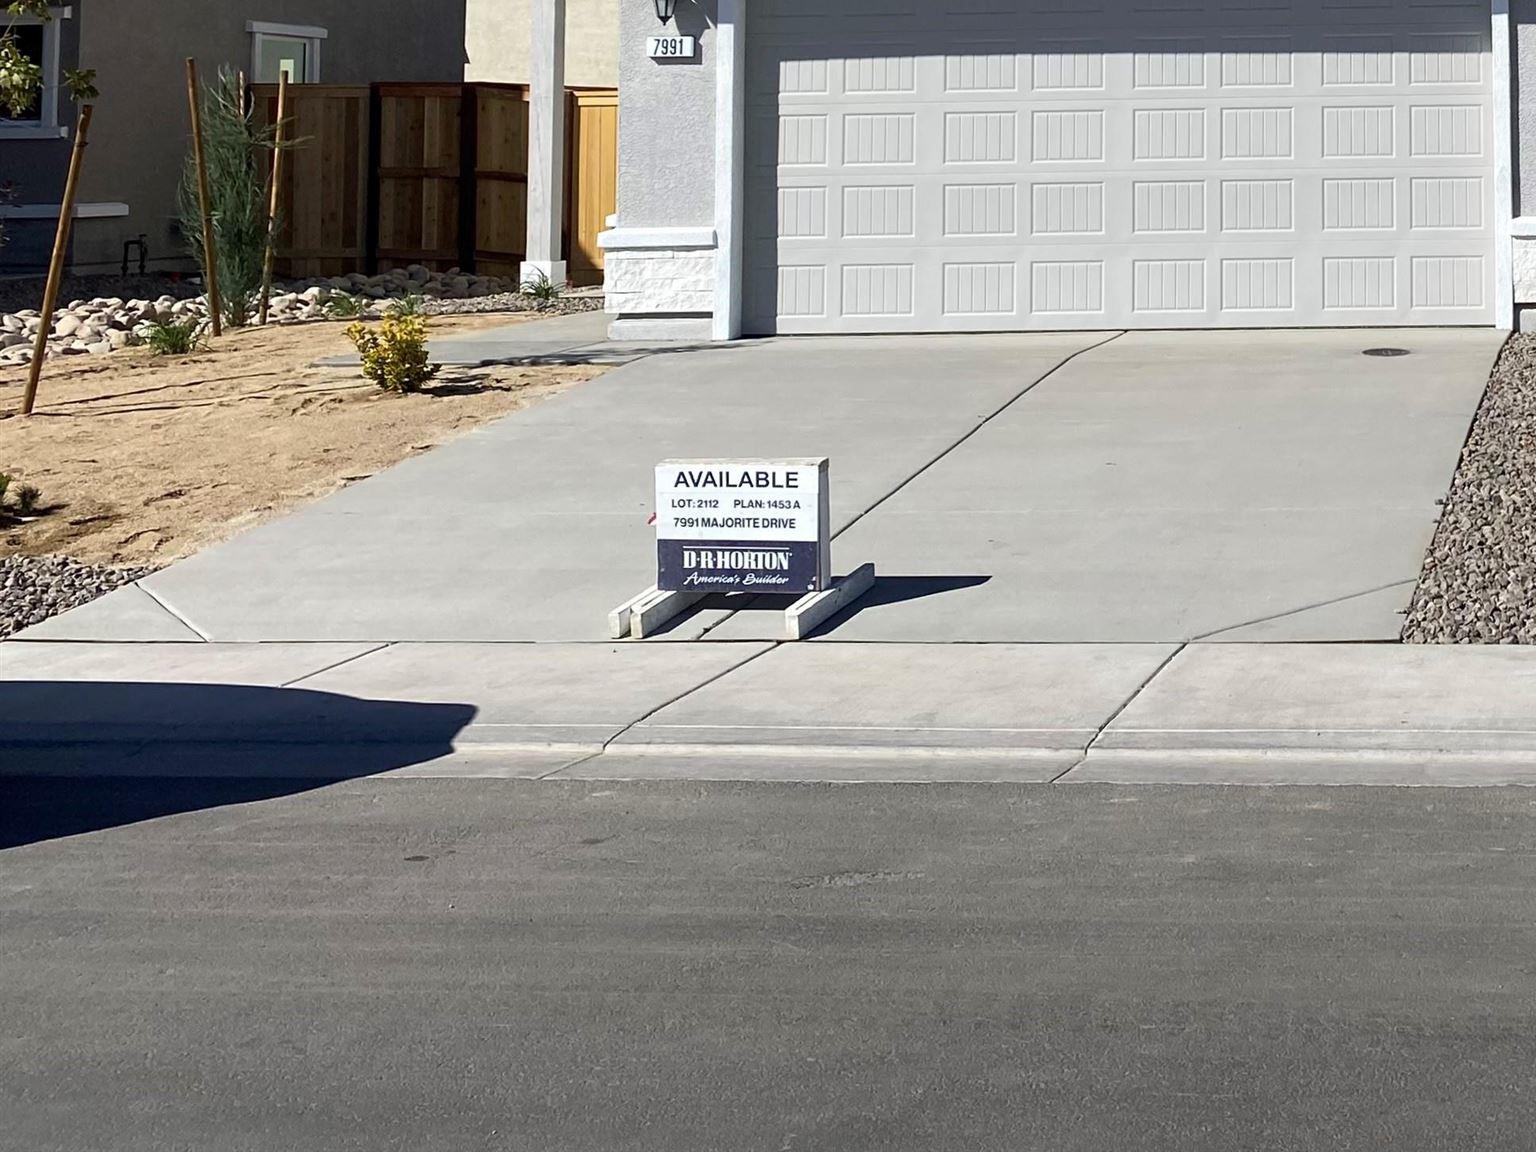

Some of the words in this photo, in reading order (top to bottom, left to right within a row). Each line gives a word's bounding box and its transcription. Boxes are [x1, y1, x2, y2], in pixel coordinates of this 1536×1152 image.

[653, 38, 684, 55] 7991
[674, 471, 799, 488] AVAILABLE
[671, 499, 696, 508] LOT:
[697, 499, 719, 509] 2112
[733, 499, 766, 509] PLAN:
[767, 500, 791, 510] 1453
[792, 501, 801, 509] A
[673, 517, 699, 528] 7991
[700, 517, 760, 529] MAJORITE
[761, 518, 796, 530] DRIVE
[683, 571, 741, 585] America's
[742, 572, 789, 585] Builder
